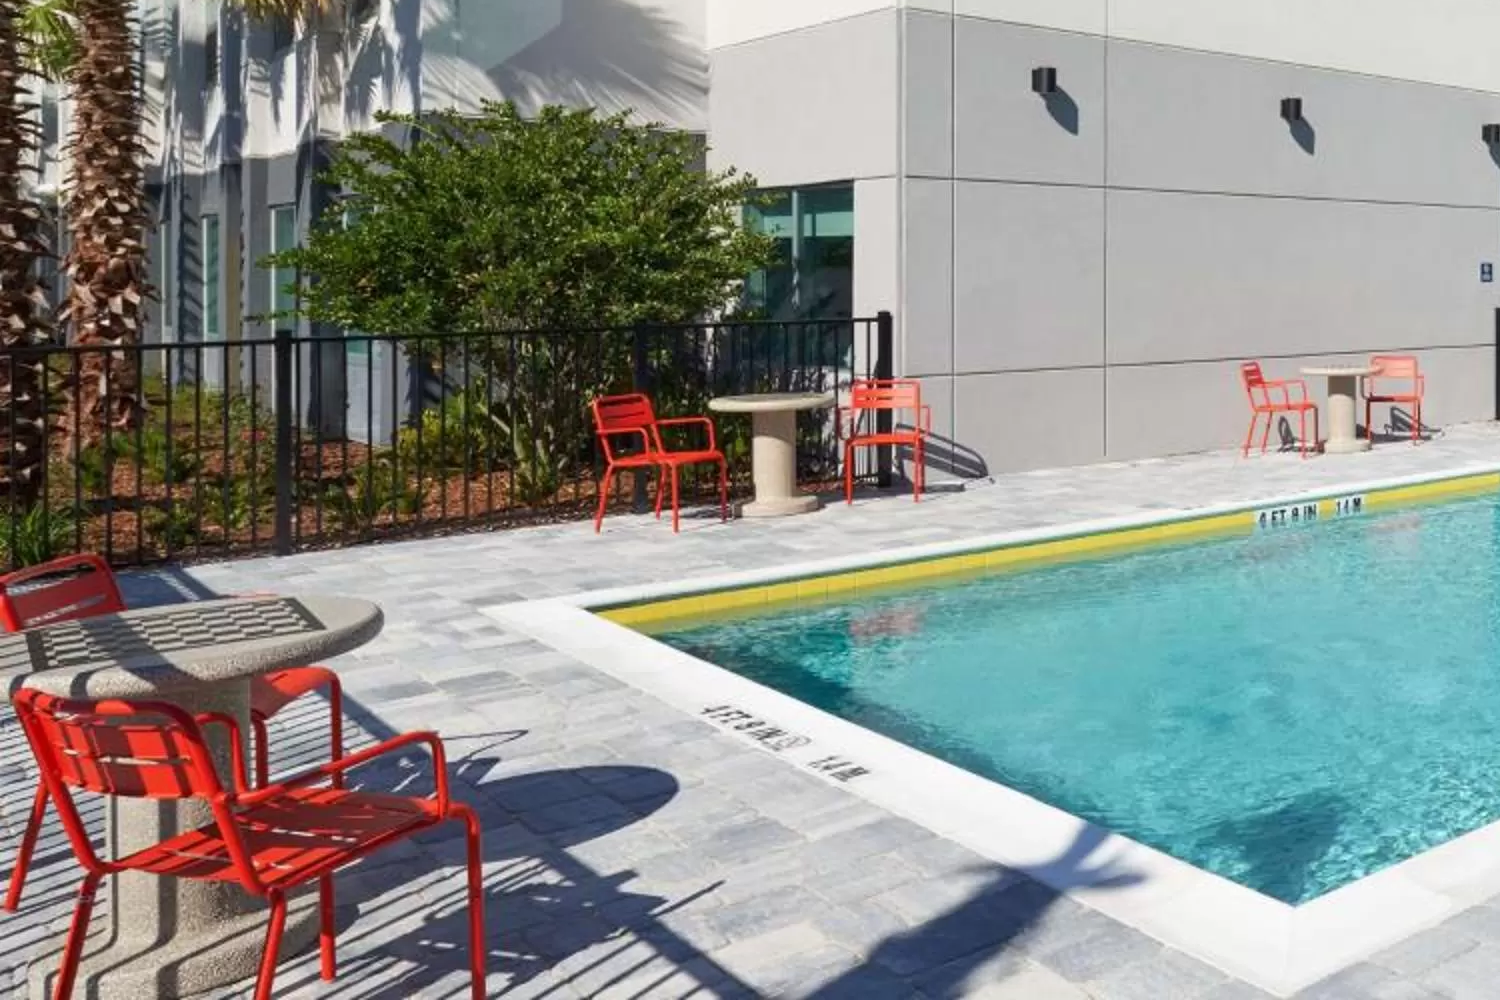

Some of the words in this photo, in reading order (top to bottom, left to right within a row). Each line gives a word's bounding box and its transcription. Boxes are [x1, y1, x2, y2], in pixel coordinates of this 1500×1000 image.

[1271, 509, 1287, 522] FT
[1303, 503, 1317, 519] IN
[1352, 497, 1362, 511] M
